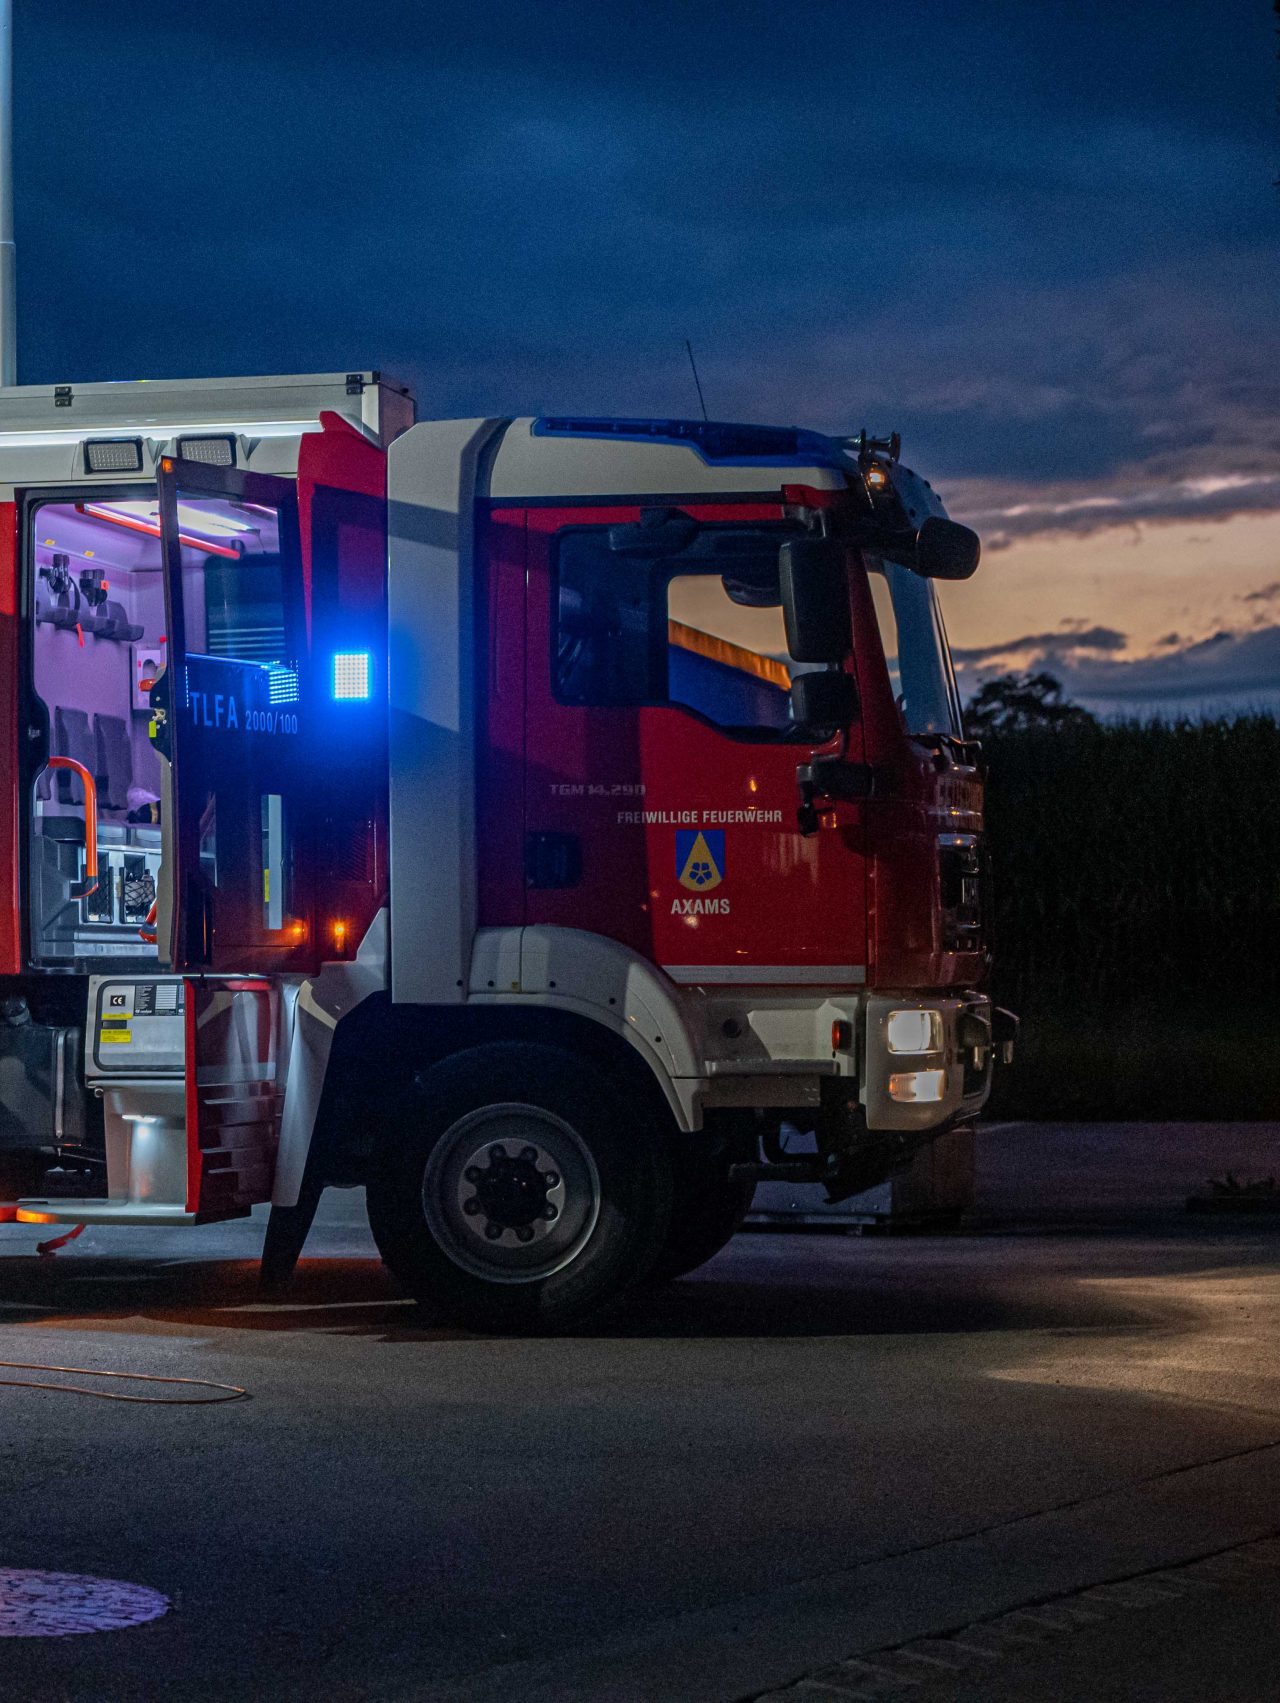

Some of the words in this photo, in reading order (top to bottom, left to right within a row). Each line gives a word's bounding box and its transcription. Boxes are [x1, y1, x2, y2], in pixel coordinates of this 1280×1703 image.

[190, 692, 238, 728] TLFA
[245, 710, 298, 735] 2000/100
[549, 783, 584, 795] TGM
[617, 810, 698, 824] FREIWILLIGE
[702, 809, 782, 823] FEUERWEHR
[671, 898, 730, 914] AXAMS
